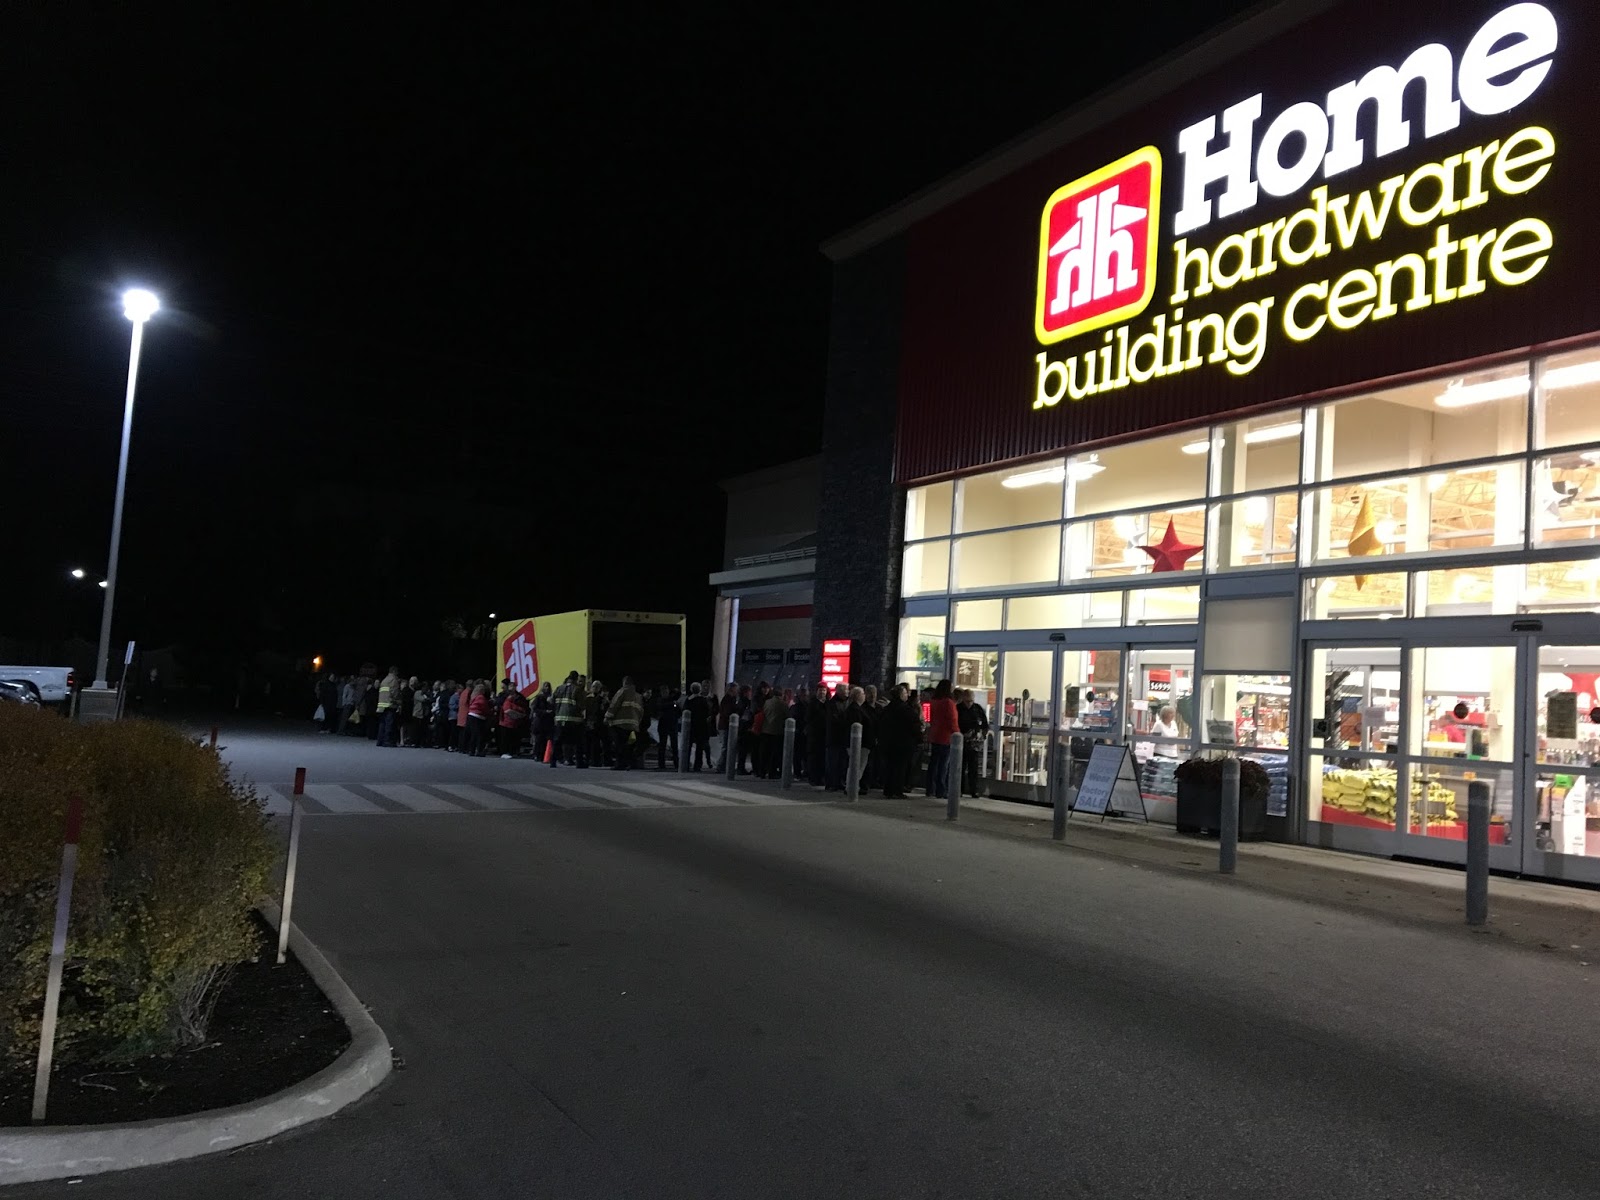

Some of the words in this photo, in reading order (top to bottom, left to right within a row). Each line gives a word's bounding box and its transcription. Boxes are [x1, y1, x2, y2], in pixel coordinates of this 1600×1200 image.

[1175, 3, 1558, 235] Home
[1170, 127, 1555, 304] hardware
[1033, 297, 1274, 409] building
[1283, 218, 1552, 341] centre
[1078, 795, 1107, 809] SALE
